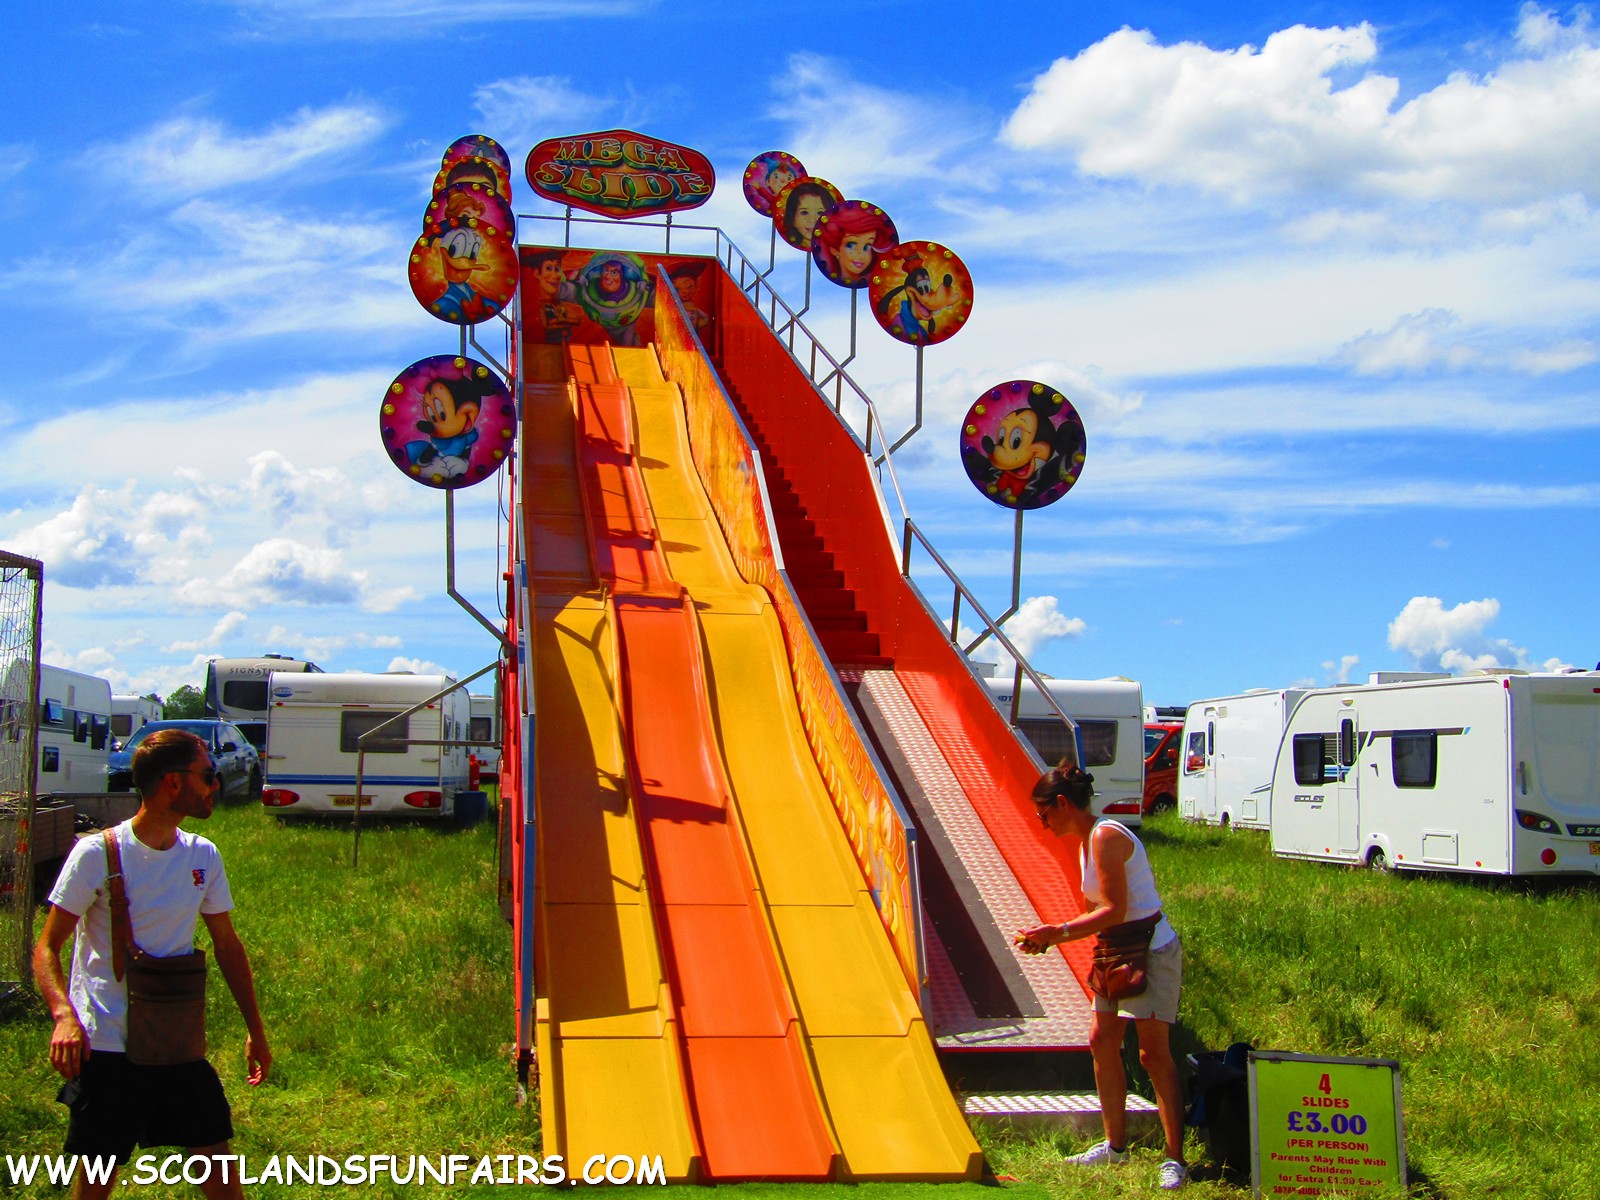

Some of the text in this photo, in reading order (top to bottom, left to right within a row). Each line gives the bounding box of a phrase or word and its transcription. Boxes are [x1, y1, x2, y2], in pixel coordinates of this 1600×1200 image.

[553, 139, 689, 172] MEGA
[534, 162, 710, 204] SLIDE
[1318, 1073, 1332, 1095] 4
[1302, 1096, 1350, 1109] SLIDES
[1287, 1111, 1367, 1135] £3.00
[1286, 1138, 1369, 1153] (PER PERSON)
[1271, 1152, 1387, 1167] Parents May Ride With
[1309, 1165, 1352, 1175] Children
[1279, 1173, 1293, 1182] for
[1296, 1174, 1324, 1184] Extra
